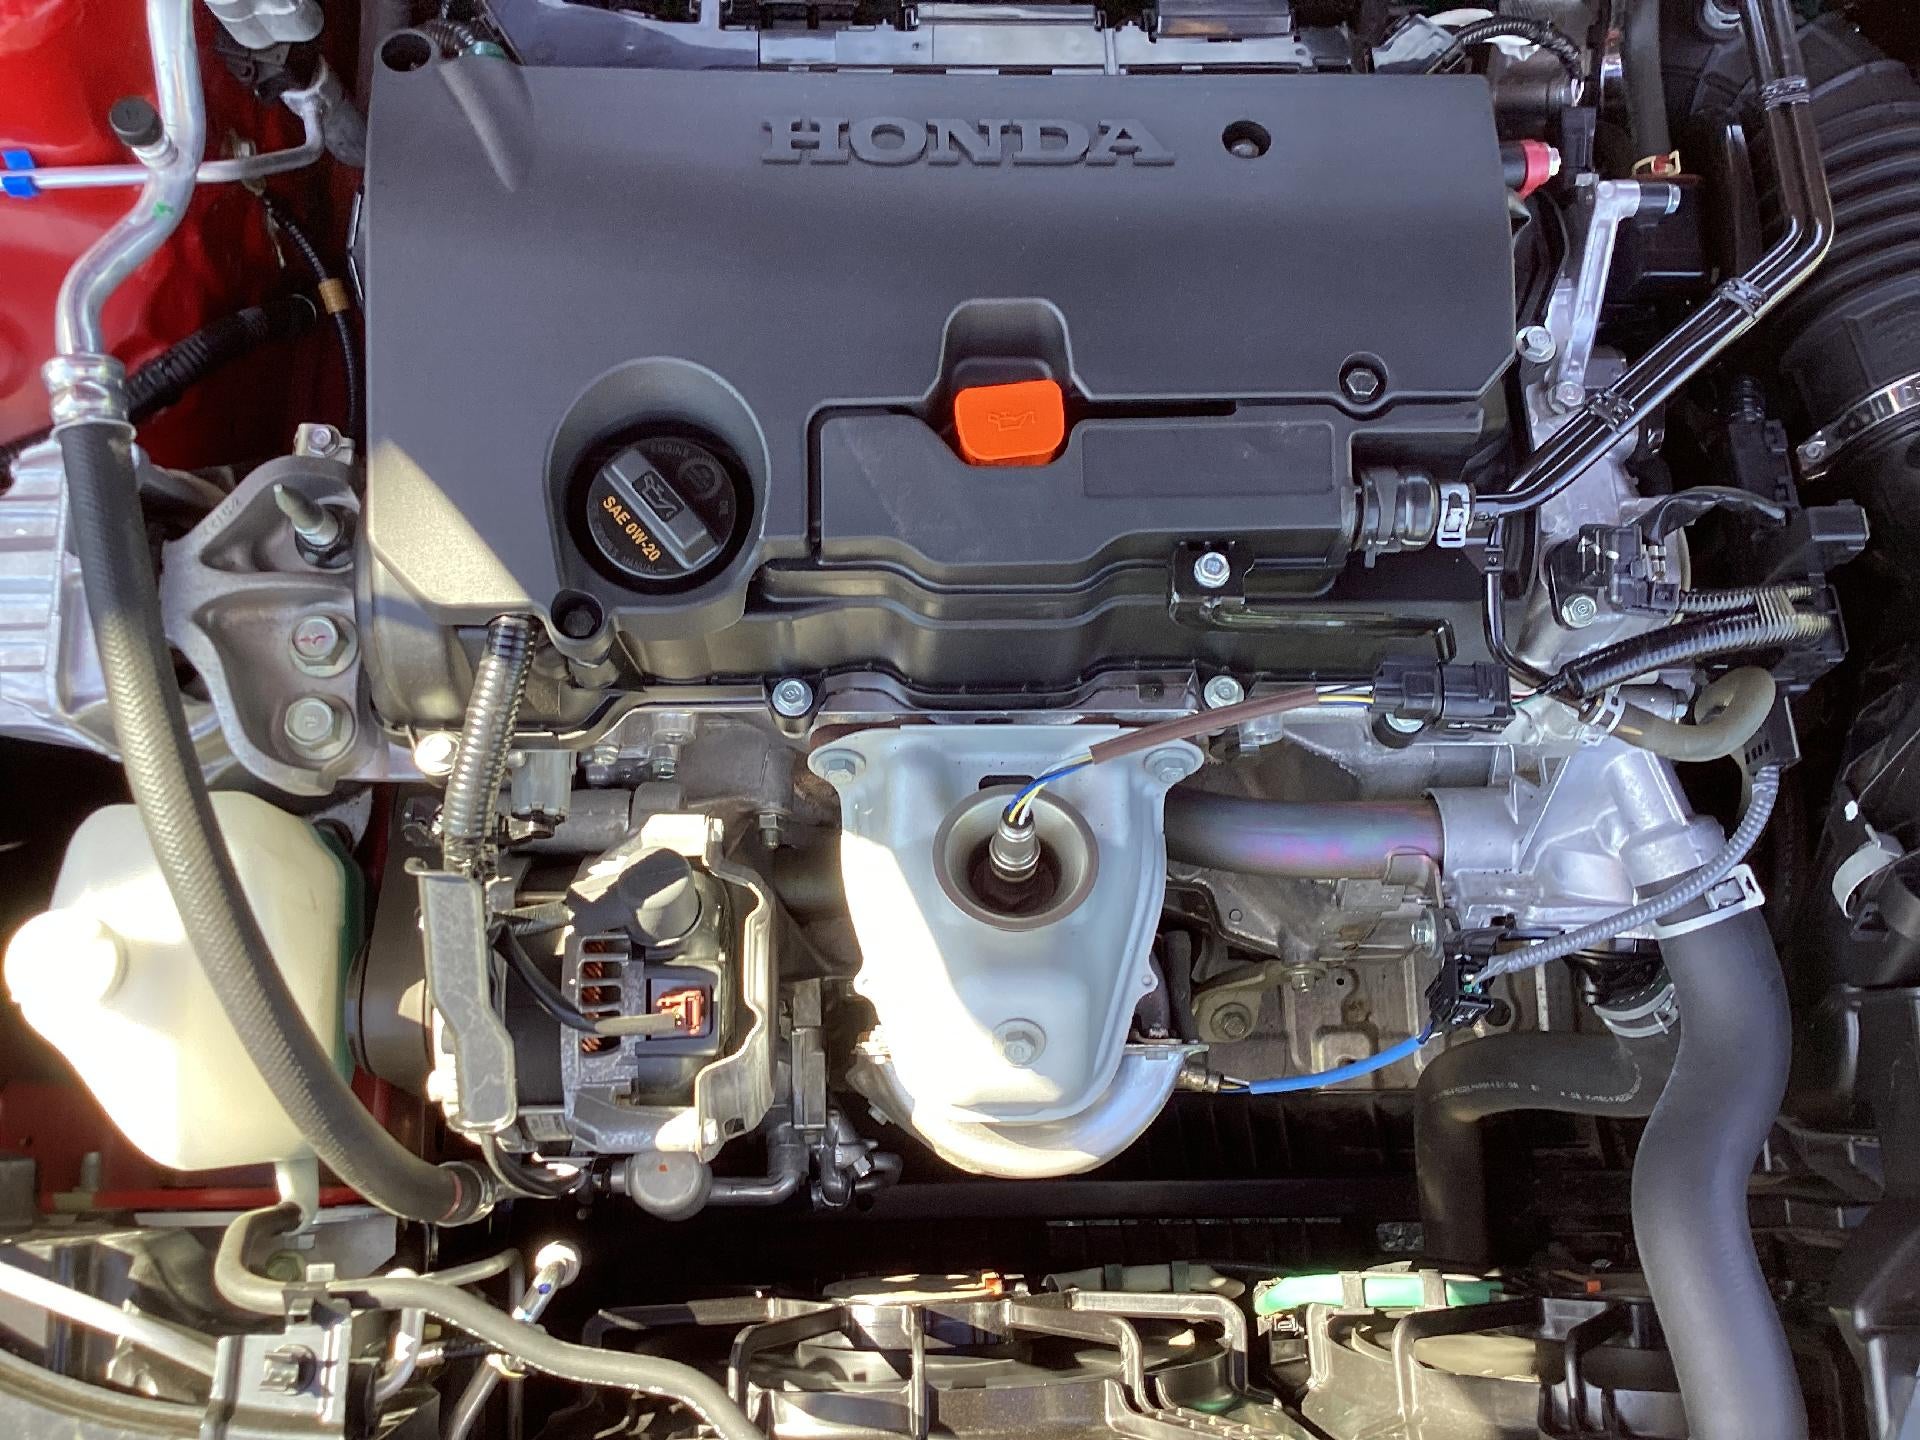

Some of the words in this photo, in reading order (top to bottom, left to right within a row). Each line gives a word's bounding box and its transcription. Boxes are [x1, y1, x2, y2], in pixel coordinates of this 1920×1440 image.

[762, 117, 1176, 167] HONDA
[602, 495, 631, 527] SAE
[625, 522, 662, 562] 0W-20
